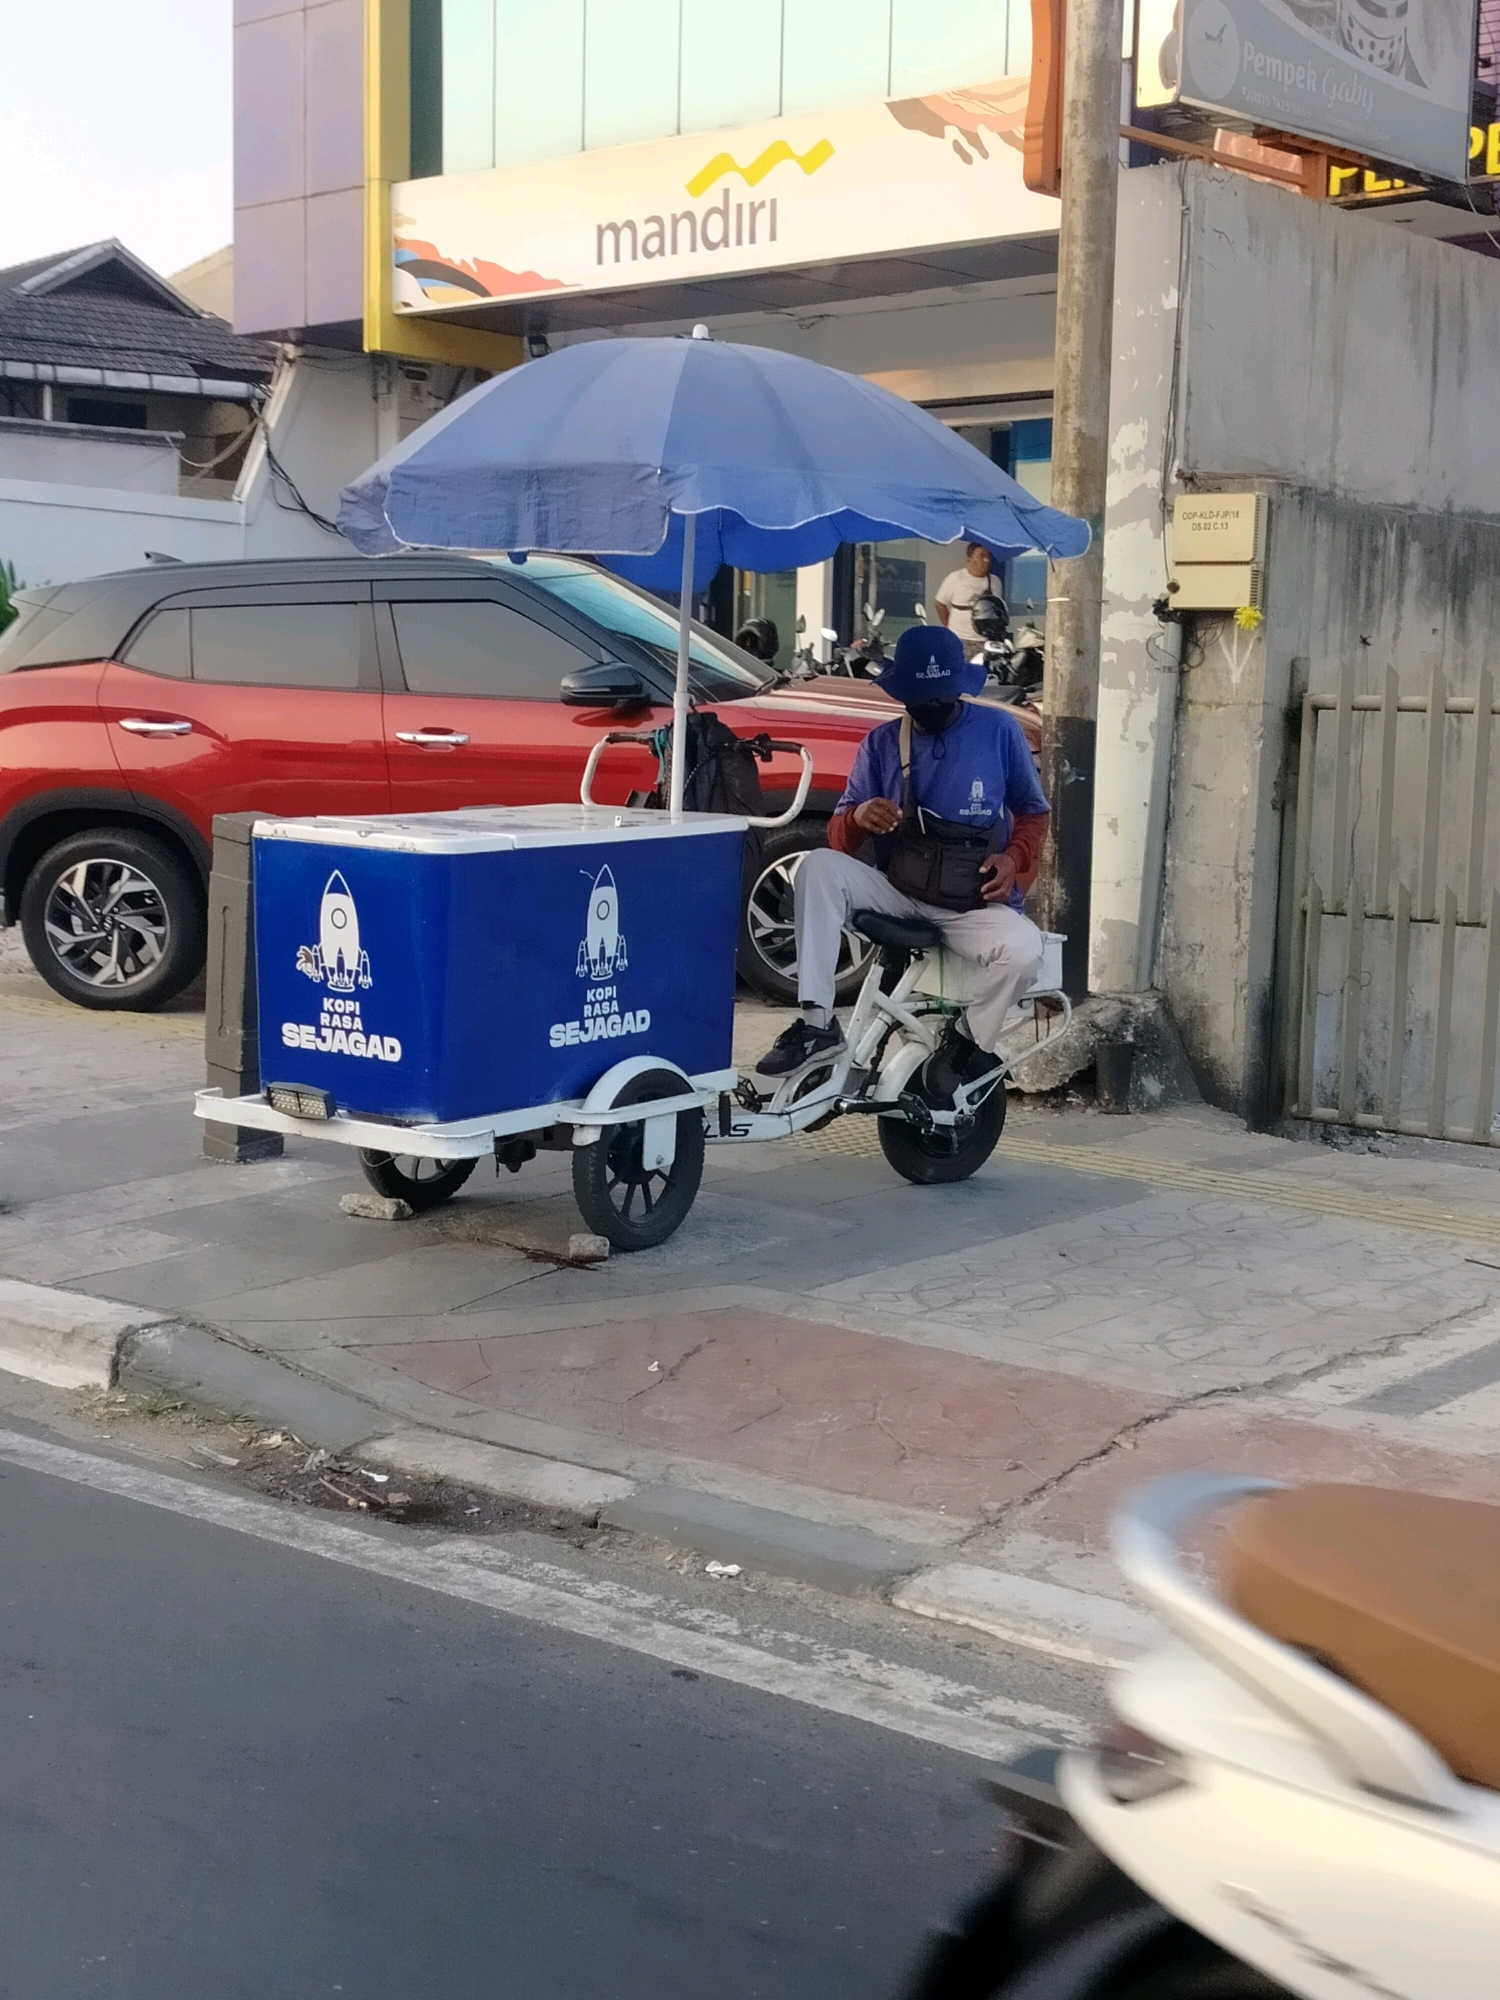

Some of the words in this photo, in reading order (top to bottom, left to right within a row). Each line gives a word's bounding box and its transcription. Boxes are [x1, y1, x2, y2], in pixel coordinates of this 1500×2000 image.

[1243, 40, 1317, 94] Pempek
[1322, 67, 1375, 120] Gaby
[596, 188, 777, 265] mandiri
[323, 997, 361, 1015] KOPI
[583, 1000, 619, 1018] RASA
[586, 986, 617, 1003] KOPI
[320, 1012, 363, 1032] RASA
[549, 1009, 651, 1048] SEJAGAD
[281, 1022, 402, 1062] SEJAGAD
